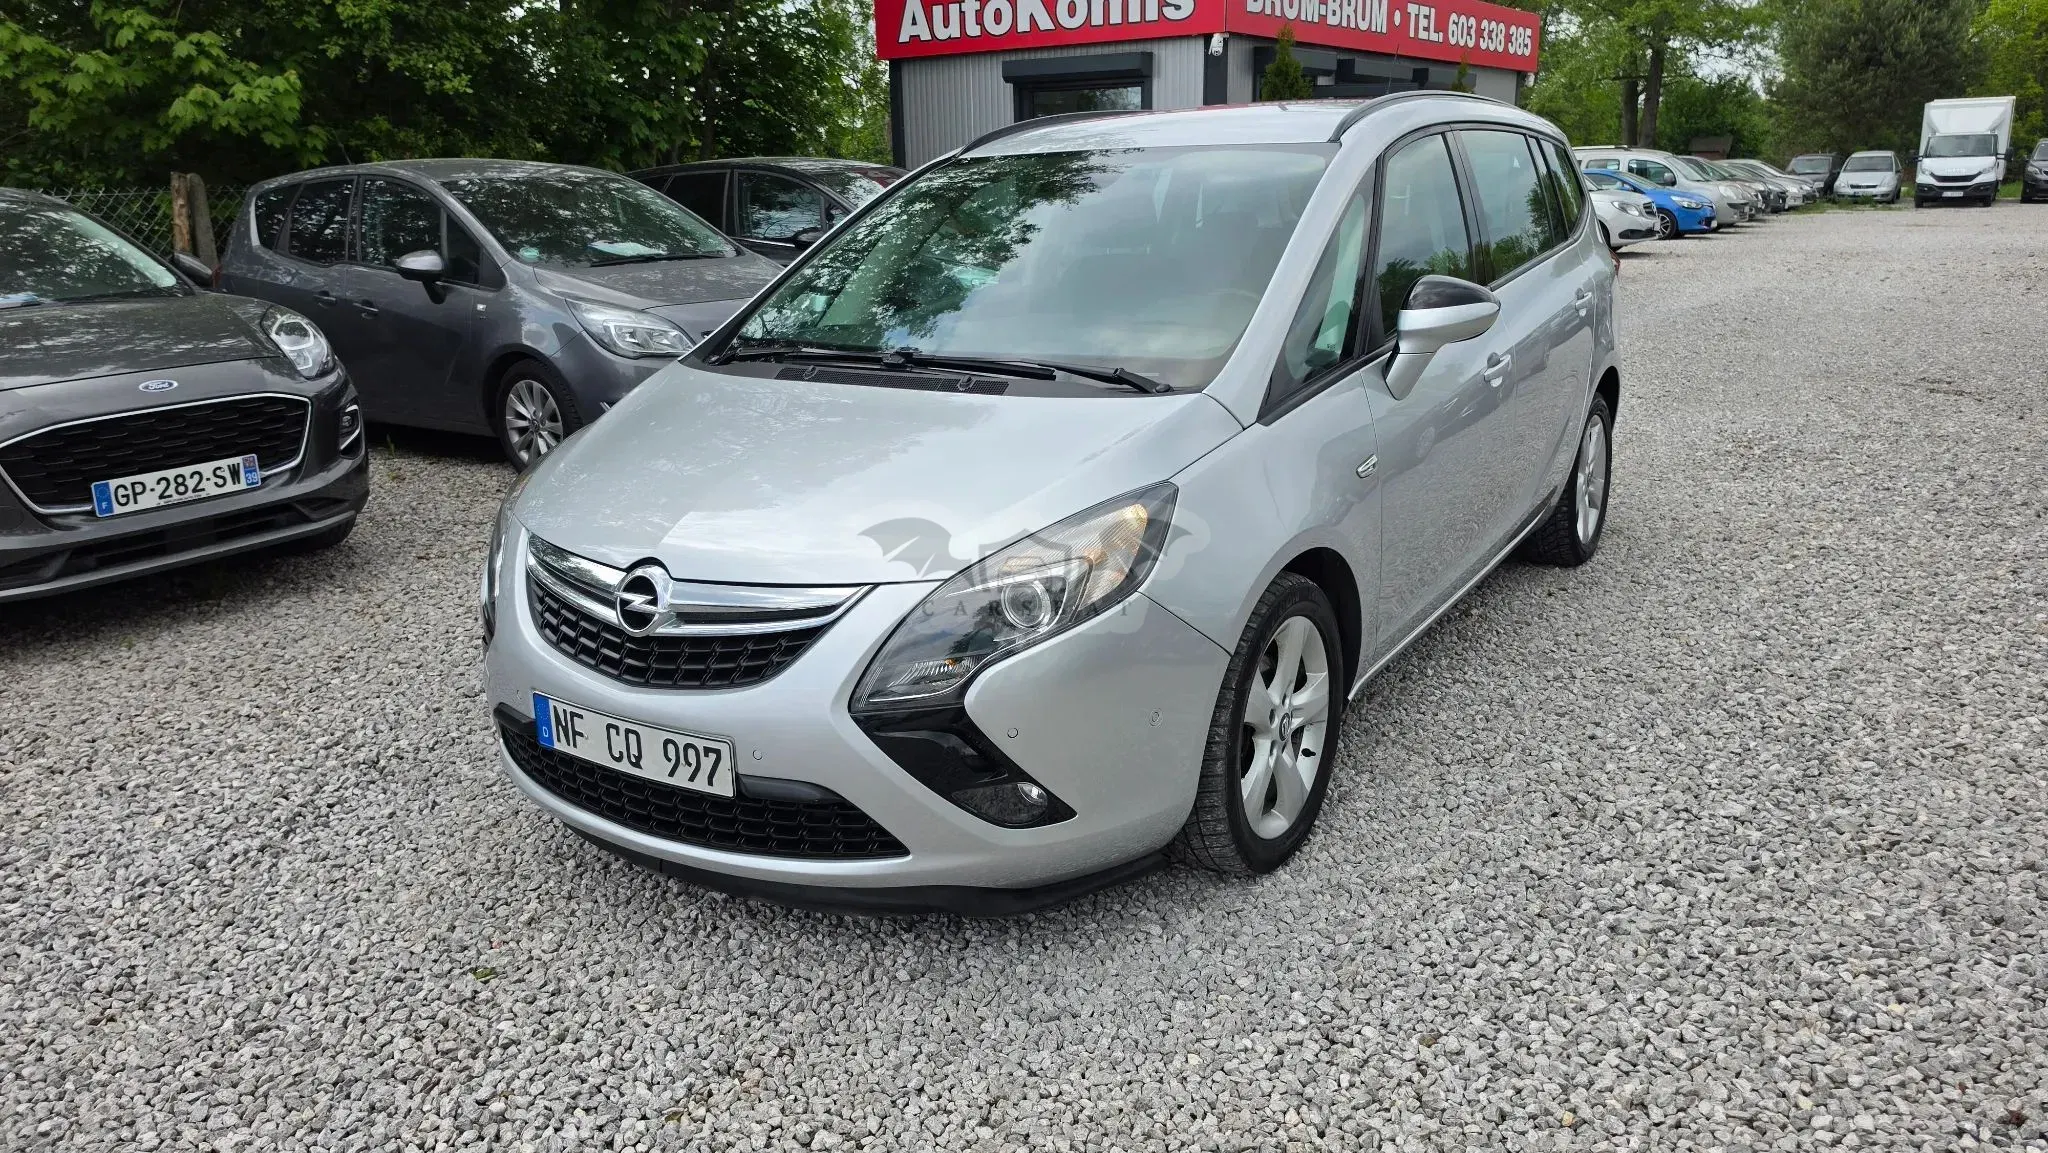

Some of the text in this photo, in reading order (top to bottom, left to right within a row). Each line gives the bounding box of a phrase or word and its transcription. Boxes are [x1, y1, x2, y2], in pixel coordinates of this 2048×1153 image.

[1407, 2, 1444, 43] TEL.
[1448, 12, 1477, 49] 603
[1479, 19, 1506, 53] 338
[1508, 24, 1532, 57] 385
[143, 381, 172, 391] Ford
[246, 471, 258, 484] 39
[113, 462, 241, 507] GP-282-SW
[102, 501, 108, 510] F
[542, 726, 549, 738] D
[553, 704, 722, 787] NF CQ 997
